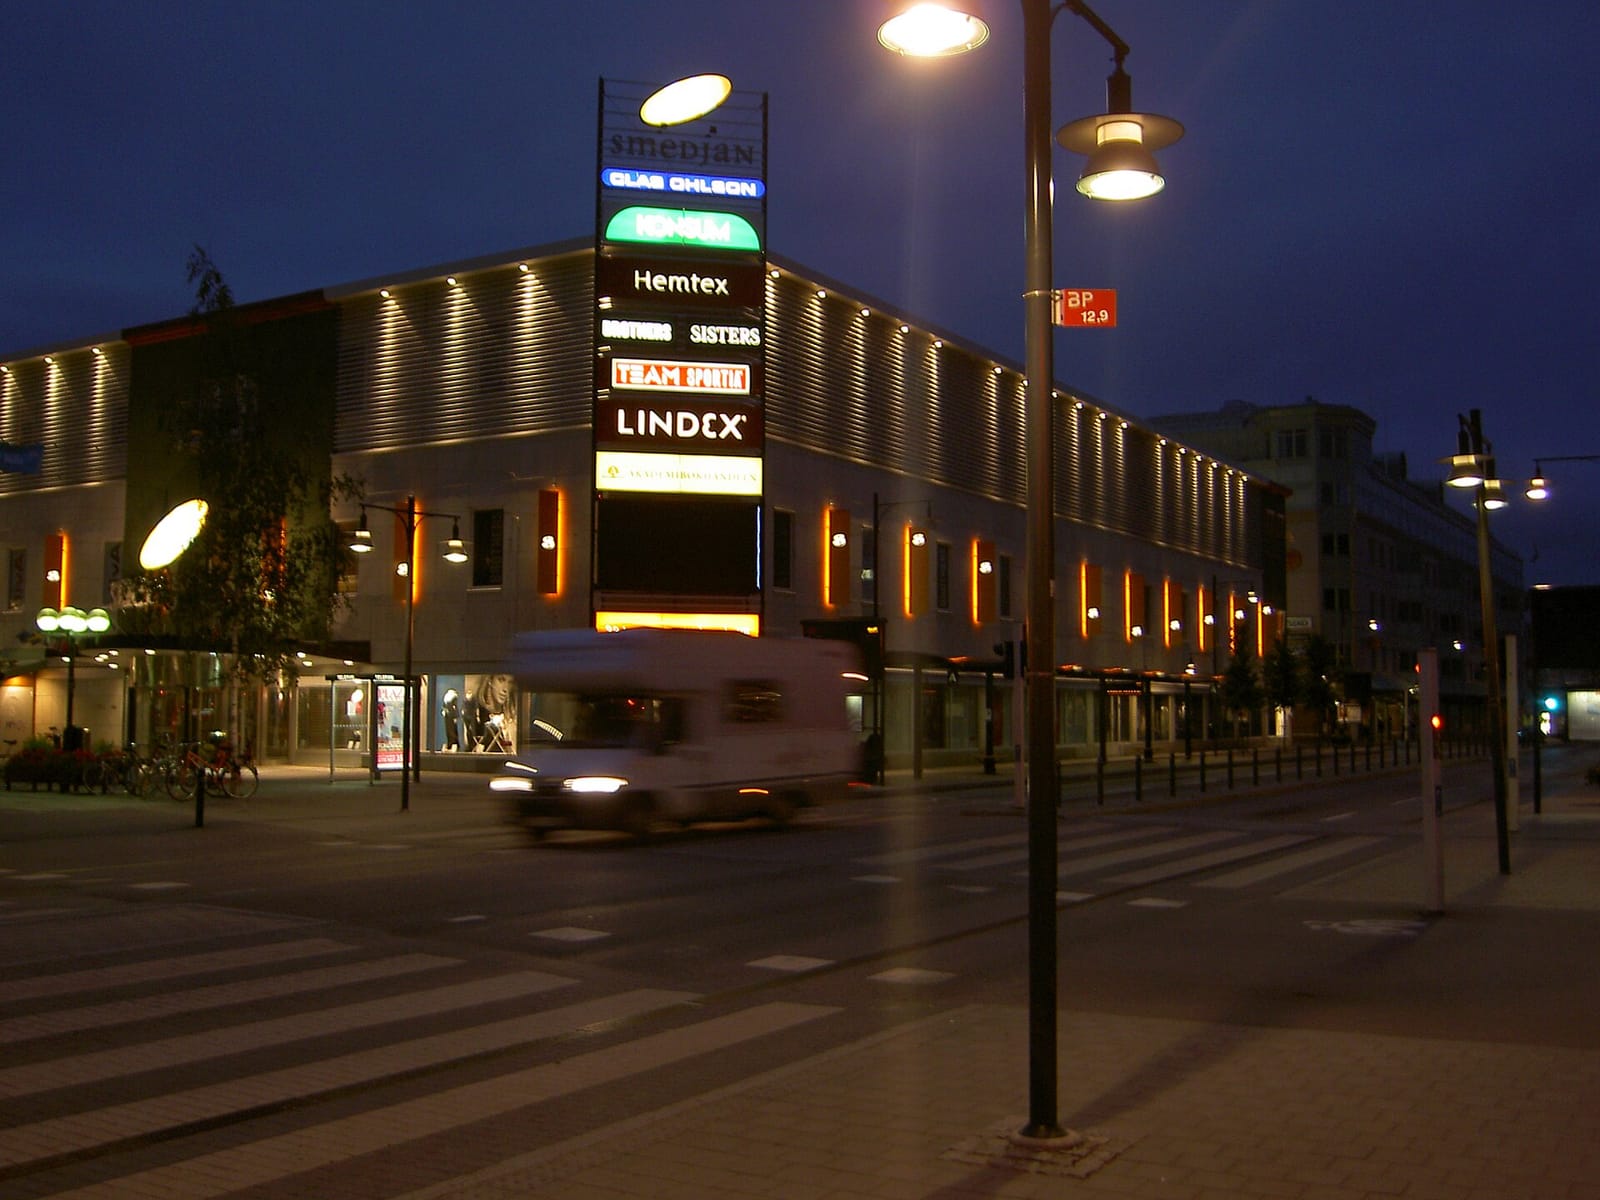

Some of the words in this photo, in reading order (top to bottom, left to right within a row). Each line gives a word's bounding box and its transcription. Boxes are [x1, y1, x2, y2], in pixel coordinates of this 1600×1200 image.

[669, 177, 756, 197] OHLSON
[635, 213, 730, 242] KONSUM
[634, 269, 729, 295] Hemtex
[1067, 291, 1094, 308] BP
[601, 319, 672, 342] BROTHERS
[690, 324, 761, 346] SISTERS
[617, 363, 680, 386] TEAM
[686, 367, 743, 389] SPORTIA
[617, 408, 744, 440] LINDEX
